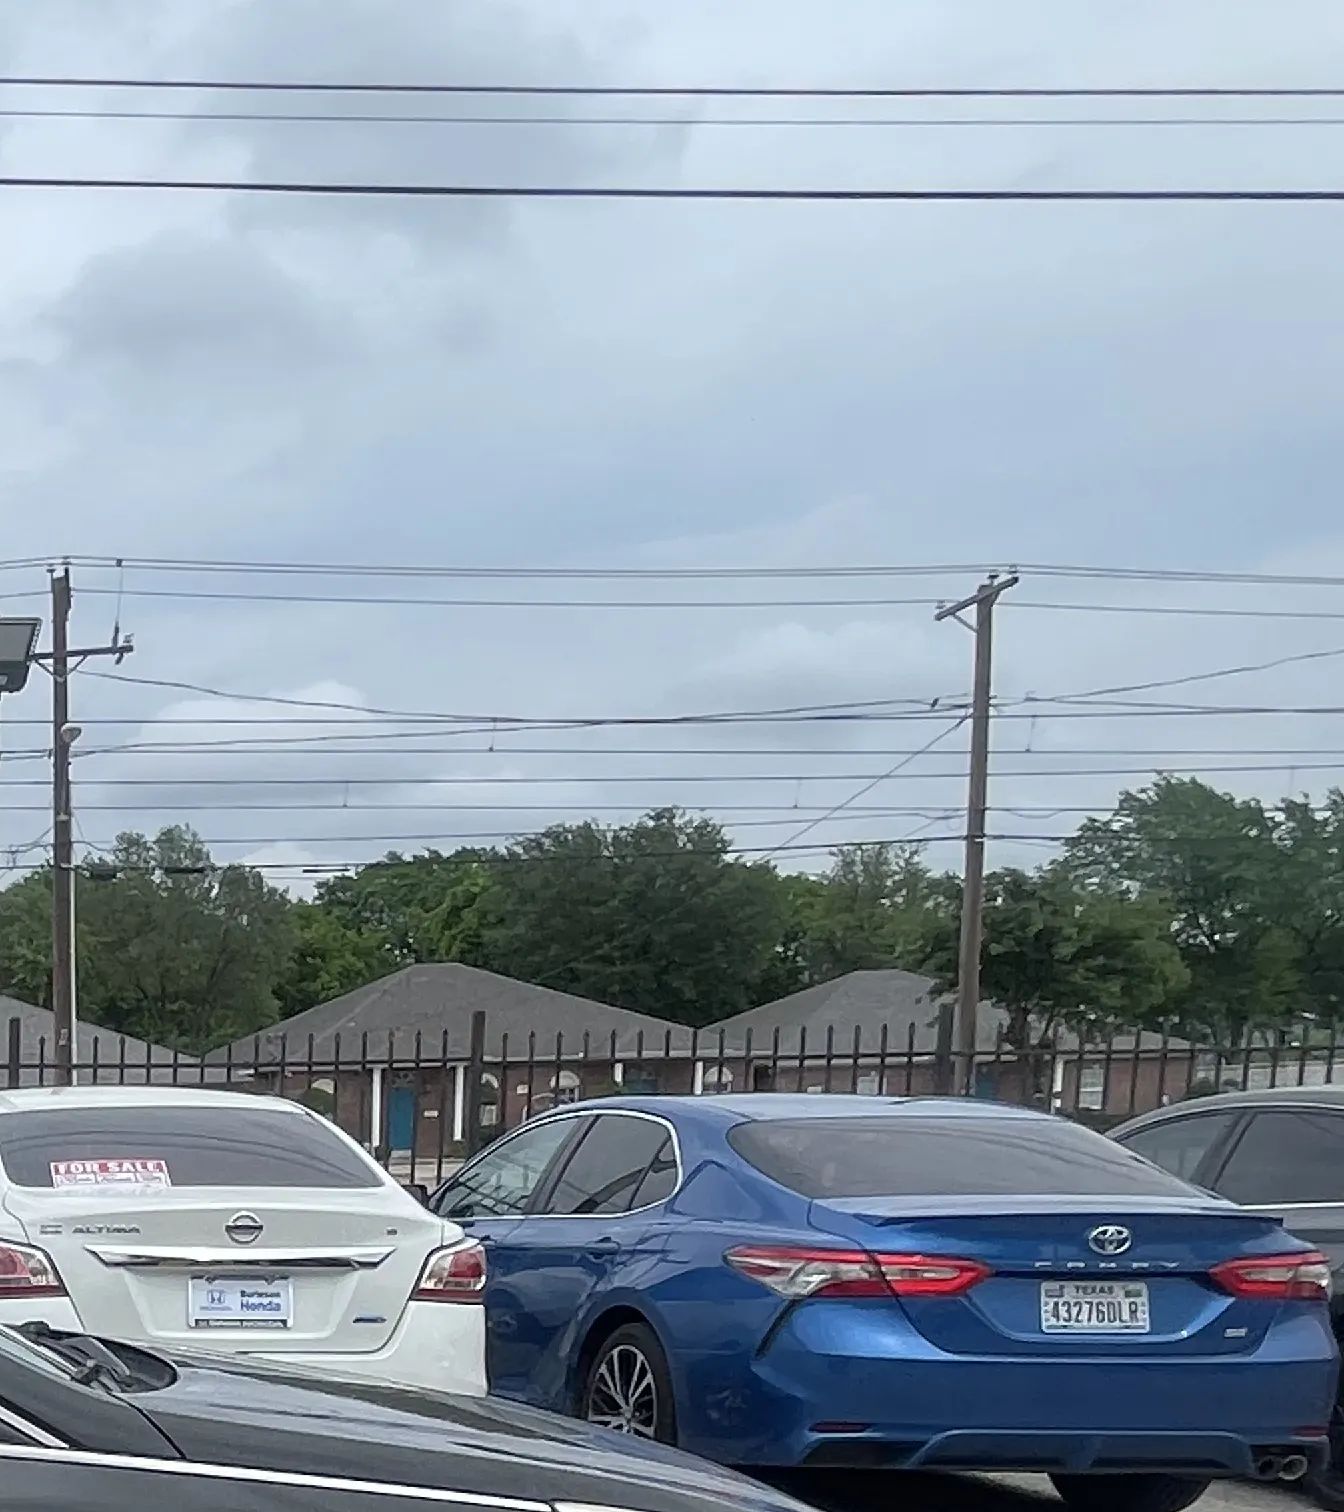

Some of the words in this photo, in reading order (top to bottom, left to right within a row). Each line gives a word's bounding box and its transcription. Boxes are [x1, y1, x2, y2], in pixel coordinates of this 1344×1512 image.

[55, 1161, 99, 1175] FOR
[107, 1159, 163, 1173] SALE
[72, 1225, 141, 1234] ALTIMA
[1073, 1284, 1116, 1296] TEXAS
[240, 1299, 282, 1312] Honda
